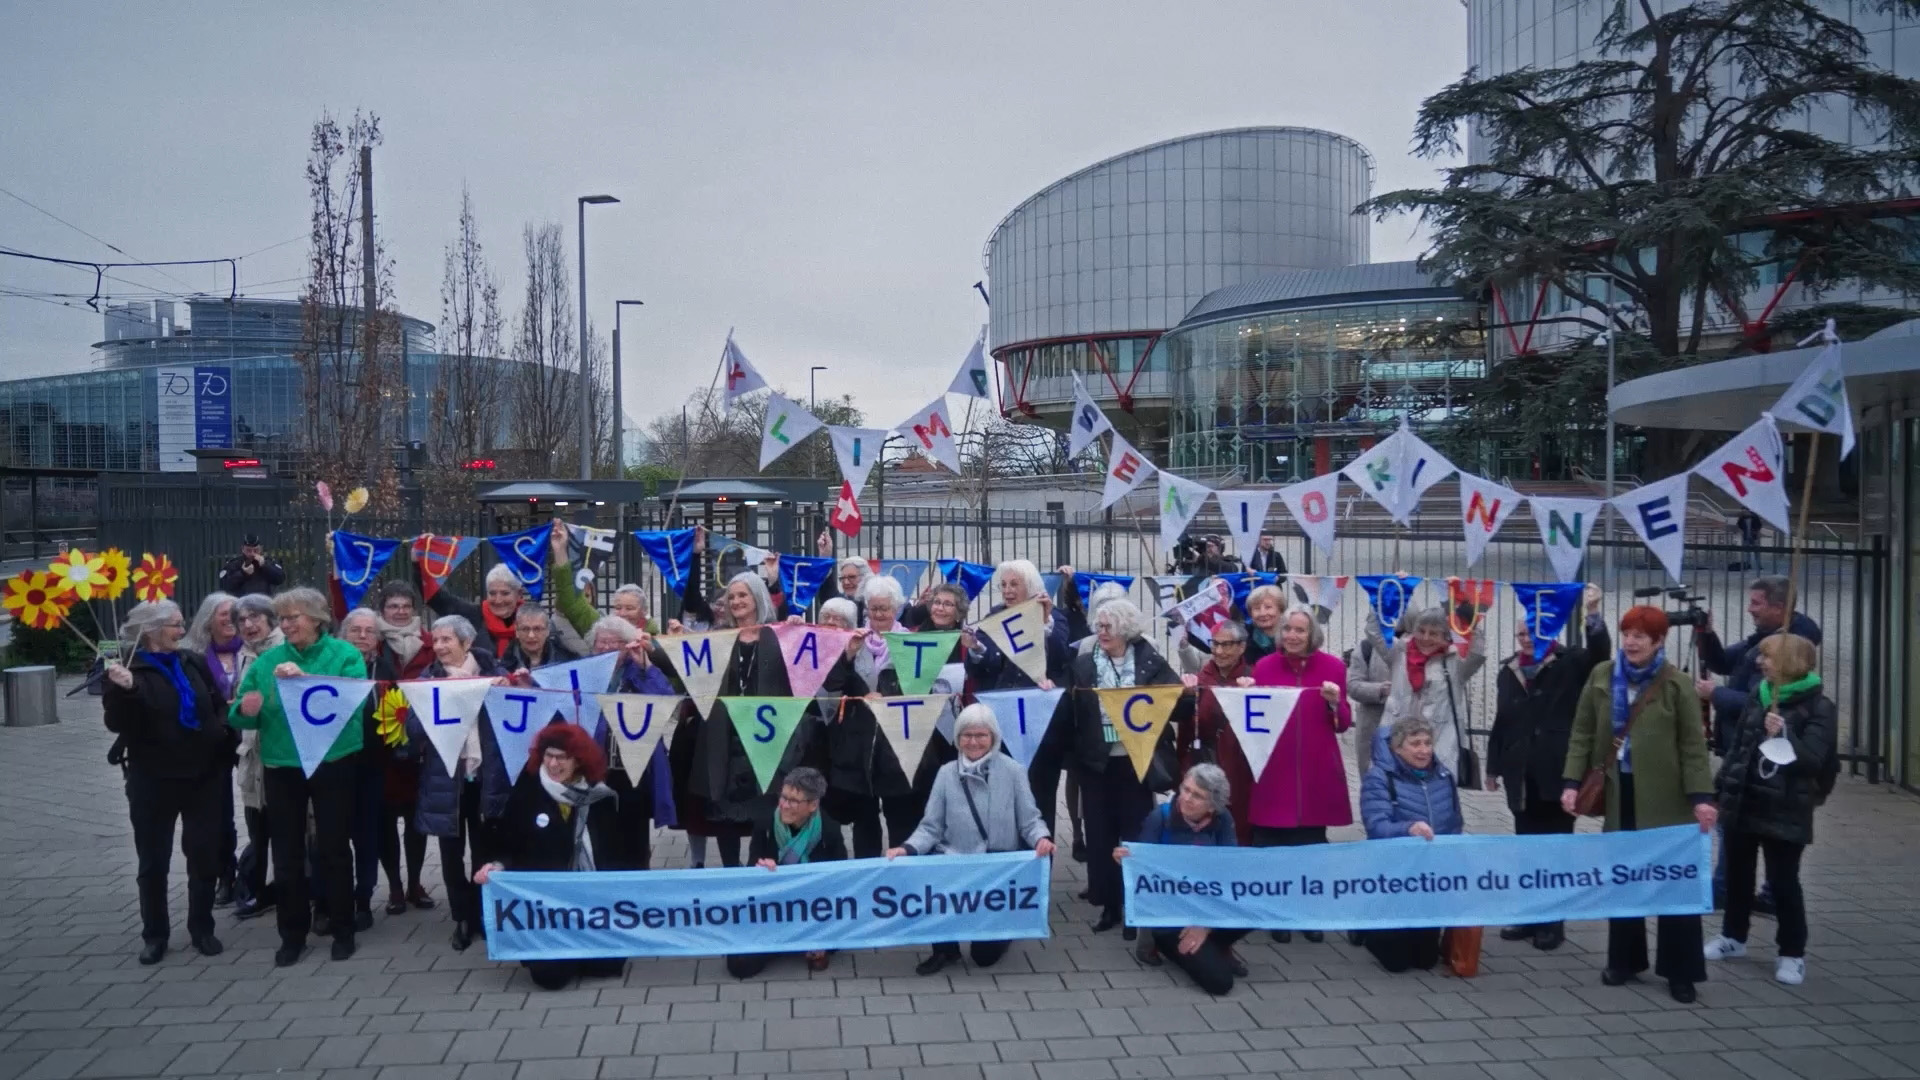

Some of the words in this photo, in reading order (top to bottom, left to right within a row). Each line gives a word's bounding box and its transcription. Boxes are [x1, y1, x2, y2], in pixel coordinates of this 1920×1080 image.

[161, 372, 190, 396] 70
[198, 372, 228, 396] 70
[1135, 873, 1223, 897] Aînées
[1231, 880, 1293, 901] pour
[1301, 875, 1324, 896] la
[1333, 871, 1468, 899] protection
[1477, 870, 1510, 891] du
[1518, 867, 1604, 890] climat
[1611, 863, 1698, 885] Suisse
[495, 896, 858, 932] KlimaSeniorinnen
[872, 879, 1040, 919] Schweiz
